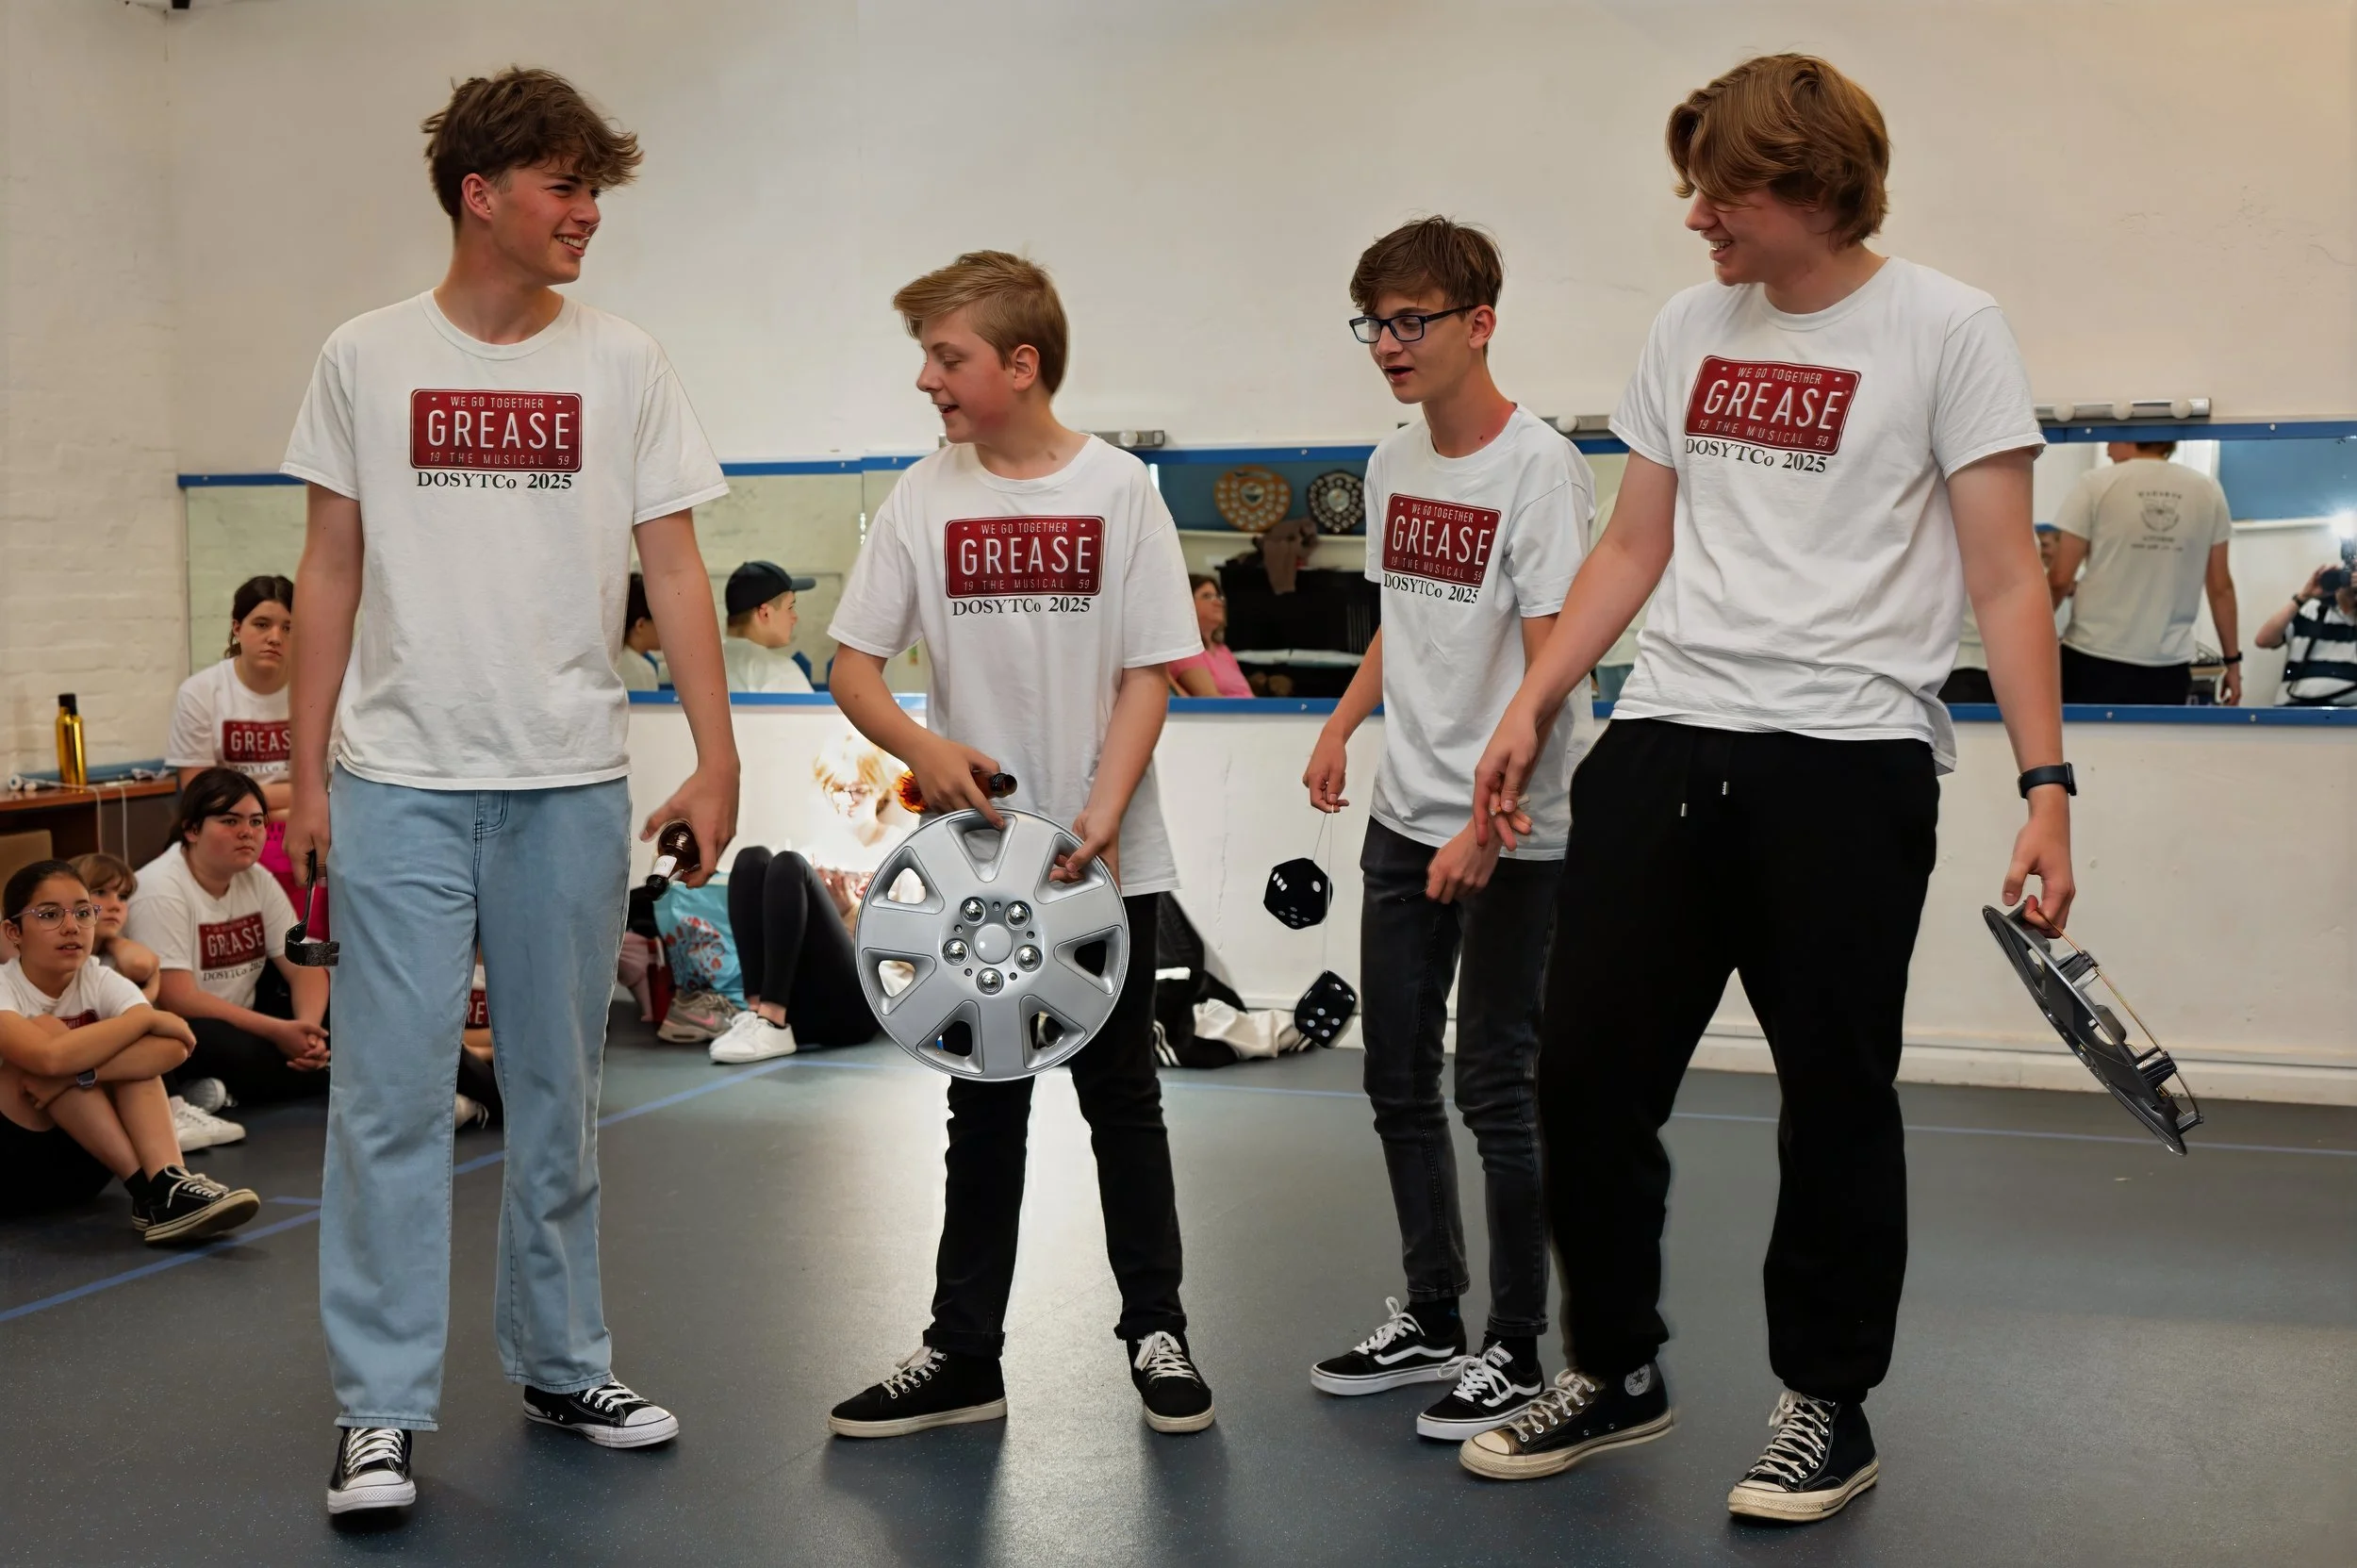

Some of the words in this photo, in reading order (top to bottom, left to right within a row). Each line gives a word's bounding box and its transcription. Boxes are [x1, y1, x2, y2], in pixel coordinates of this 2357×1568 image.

[1737, 367, 1752, 378] WE
[1755, 368, 1767, 378] GO
[1772, 368, 1822, 385] TOGETHER
[451, 396, 466, 406] WE
[471, 396, 485, 407] GO
[490, 398, 544, 409] TOGETHER
[1703, 379, 1843, 430] GREASE
[427, 409, 569, 450] GREASE
[1698, 419, 1709, 430] 19
[1715, 421, 1739, 434] THE
[1746, 425, 1804, 444] MUSICAL
[1816, 436, 1829, 447] 59
[430, 452, 440, 462] 19
[449, 453, 473, 464] THE
[483, 454, 544, 466] MUSICAL
[557, 455, 569, 466] 59
[1686, 438, 1774, 467] DOSYTCo
[1782, 452, 1827, 472] 2025
[417, 471, 517, 489] DOSYTCo
[526, 473, 572, 489] 2025
[1412, 503, 1422, 515] WE
[1423, 505, 1431, 516] GO
[1433, 506, 1474, 523] TOGETHER
[981, 524, 996, 535] WE
[1001, 524, 1014, 534] GO
[1018, 522, 1067, 534] TOGETHER
[1393, 515, 1490, 566] GREASE
[961, 536, 1092, 576] GREASE
[1392, 556, 1398, 566] 19
[1403, 557, 1418, 569] THE
[1424, 562, 1463, 578] MUSICAL
[1474, 571, 1482, 581] 59
[964, 581, 974, 591] 19
[982, 580, 1005, 590] THE
[1014, 579, 1064, 589] MUSICAL
[1079, 579, 1090, 589] 59
[1384, 573, 1442, 598] DOSYTCo
[1448, 586, 1479, 603] 2025
[952, 598, 1041, 616] DOSYTCo
[1048, 597, 1092, 613] 2025
[230, 730, 291, 752] GREAS
